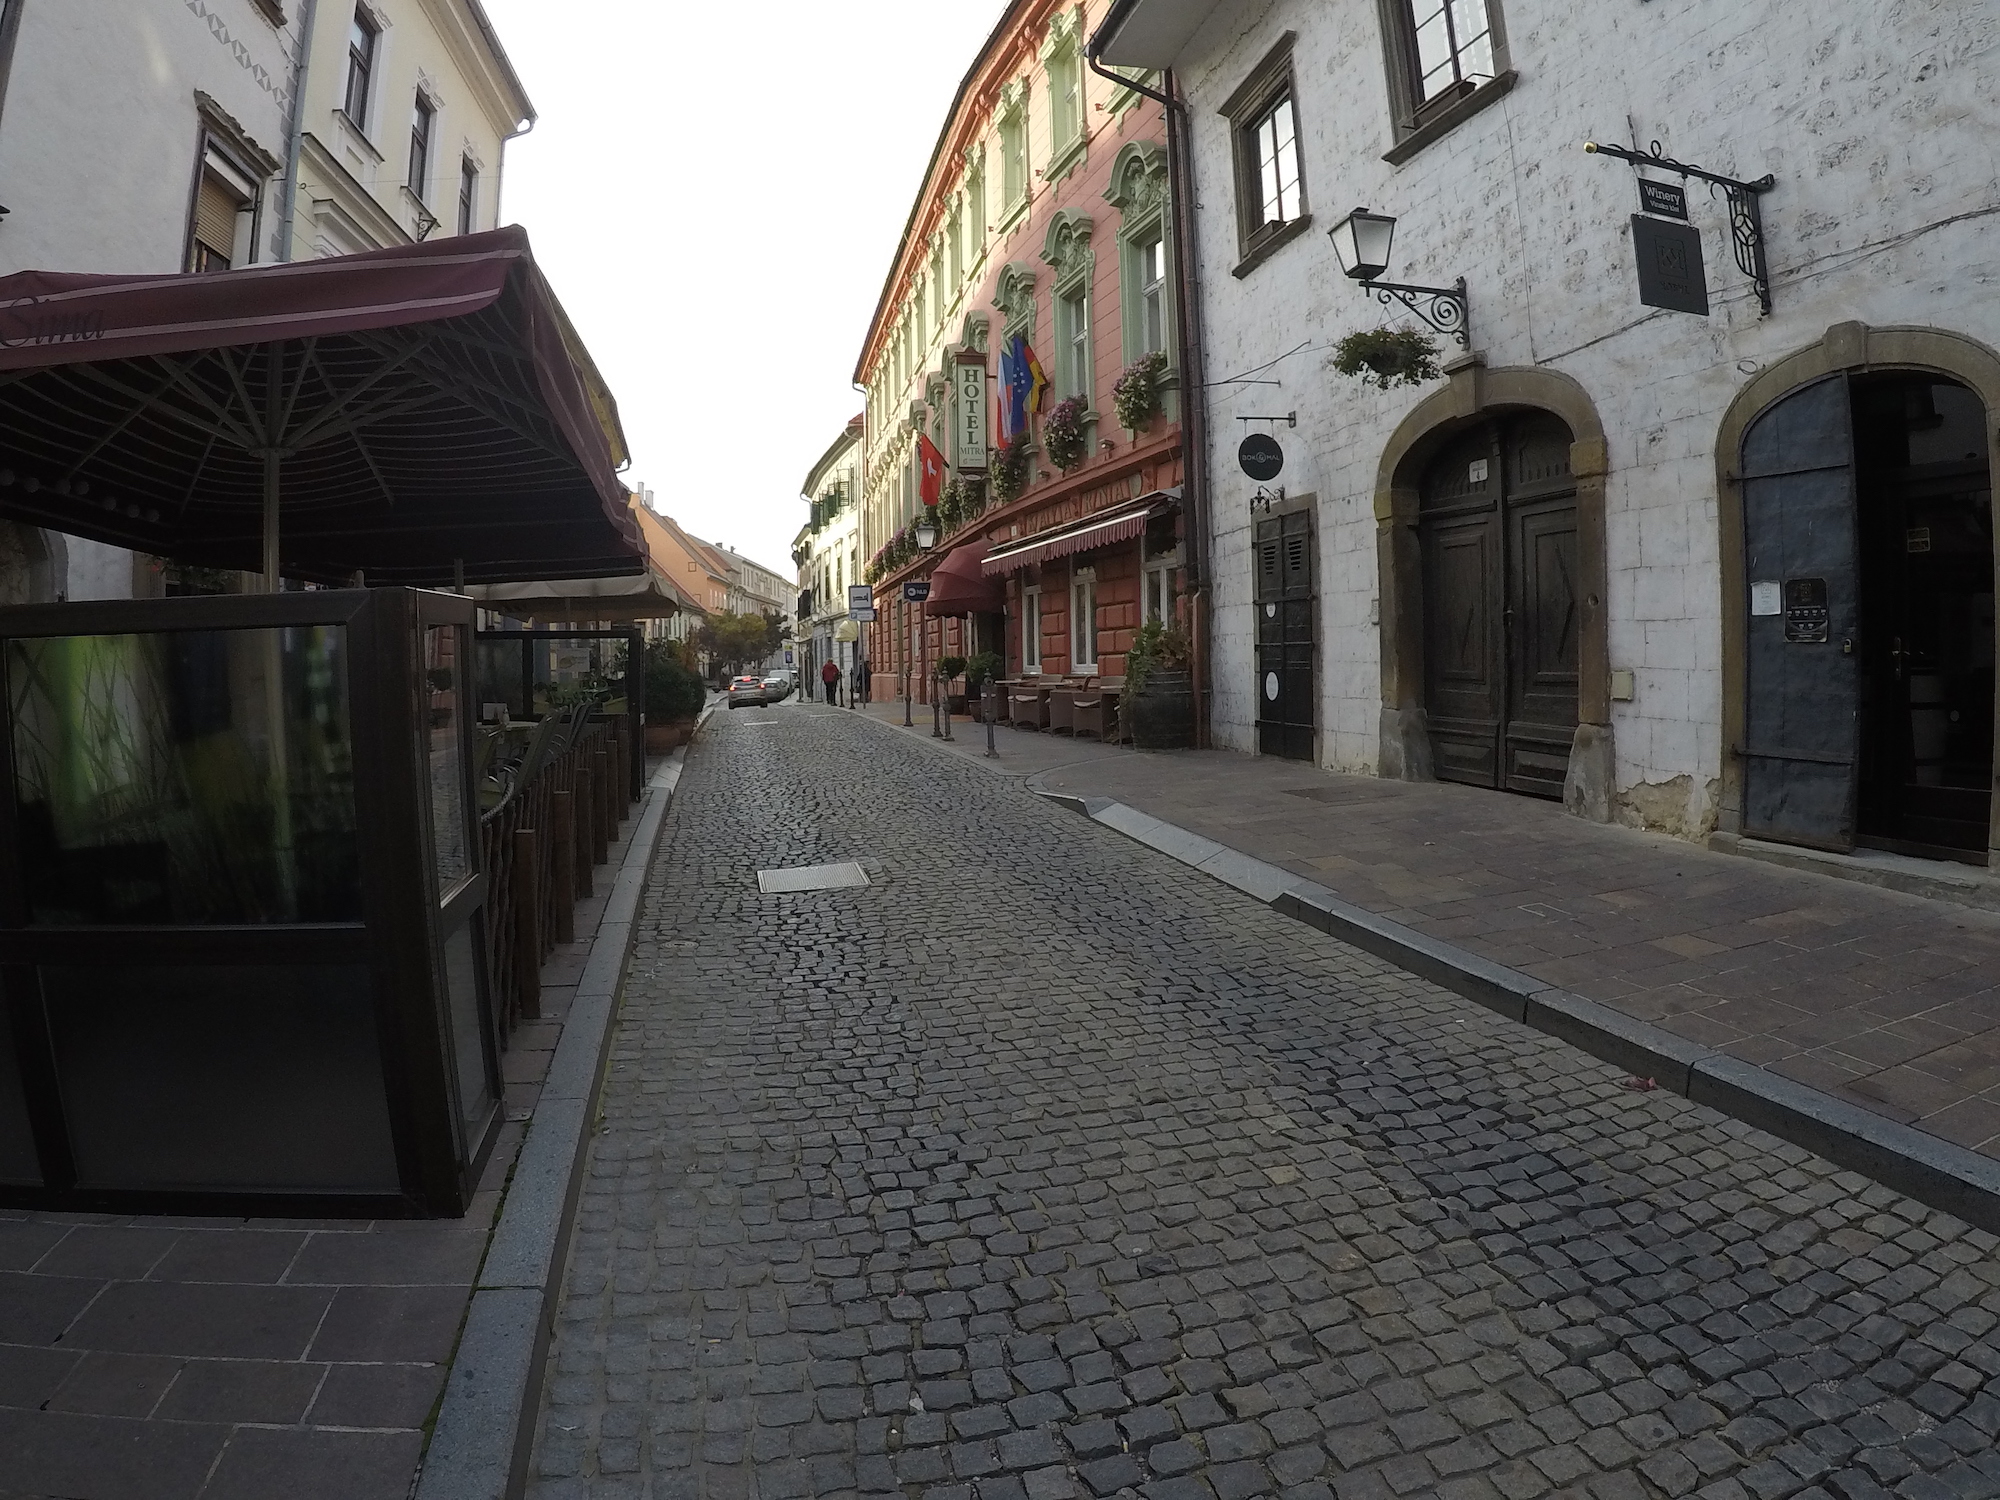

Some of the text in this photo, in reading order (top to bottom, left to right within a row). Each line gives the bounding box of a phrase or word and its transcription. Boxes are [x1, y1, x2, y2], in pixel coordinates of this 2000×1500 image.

[1644, 185, 1680, 205] Winery
[963, 369, 980, 445] HOTEL
[960, 446, 985, 456] MITRA
